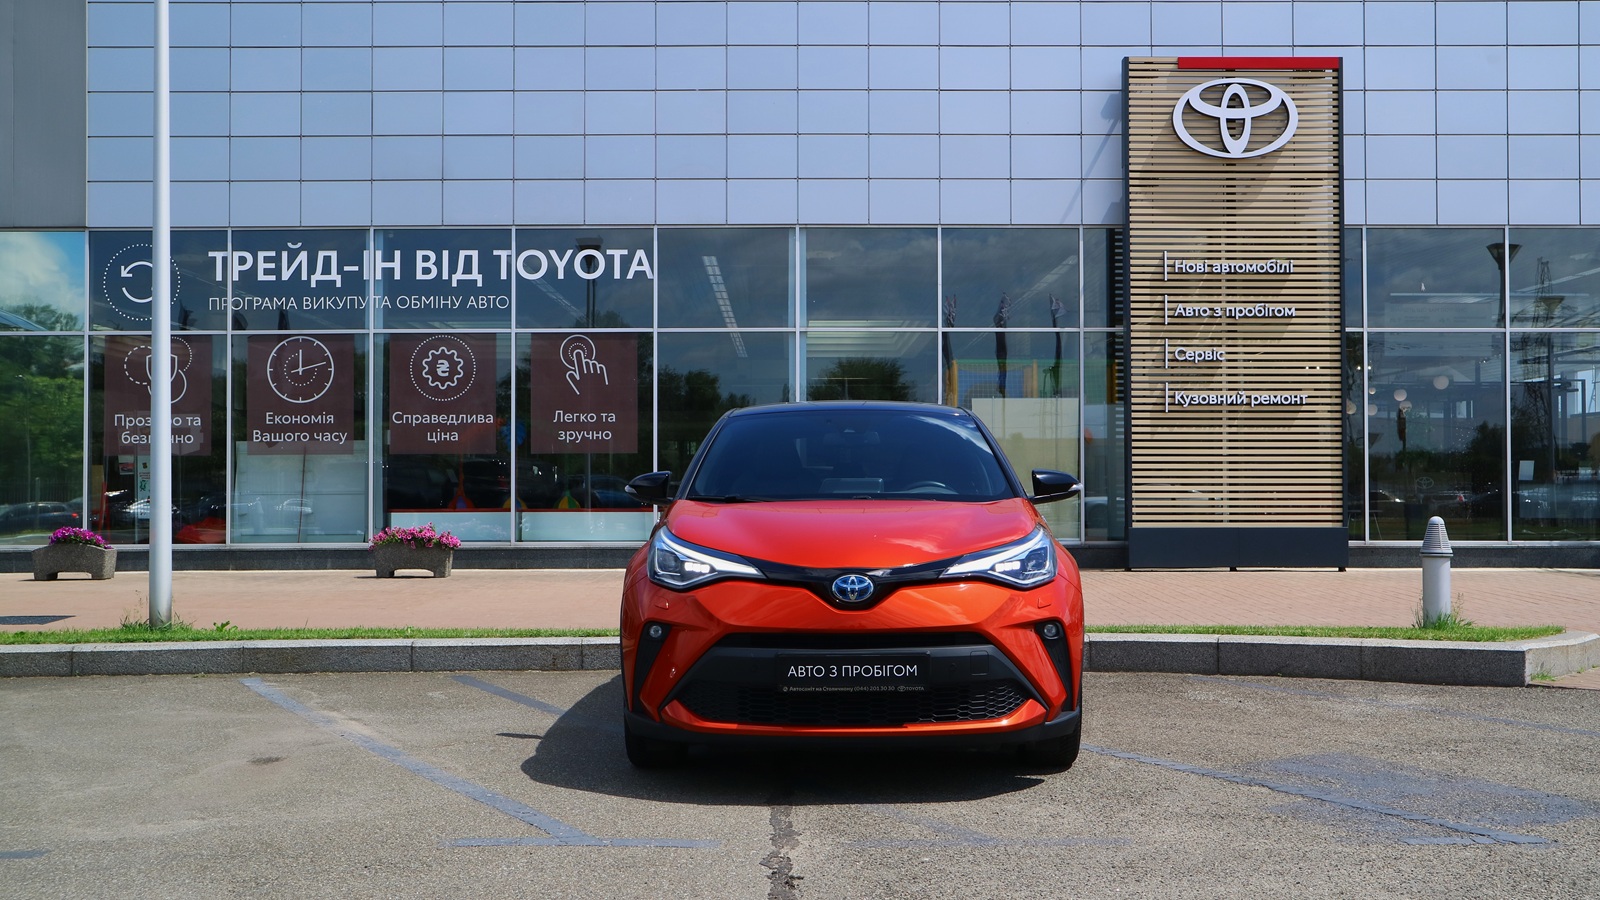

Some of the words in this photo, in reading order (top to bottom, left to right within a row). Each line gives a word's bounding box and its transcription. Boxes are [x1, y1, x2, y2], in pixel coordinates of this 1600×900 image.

[208, 242, 401, 288] ТРЕЙД-ІН
[416, 249, 483, 287] ВІД
[493, 249, 654, 280] TOYOTA
[1174, 260, 1209, 273] Нові
[1212, 260, 1295, 273] автомобілі
[209, 297, 298, 311] ПРОГРАМА
[302, 296, 369, 311] ВИКУПУ
[373, 296, 392, 310] ТА
[396, 295, 463, 310] ОБМІНУ
[466, 295, 510, 310] АВТО
[1174, 304, 1210, 317] Авто
[1213, 306, 1223, 317] з
[1225, 303, 1297, 320] пробігом
[1174, 347, 1226, 364] Сервіс
[1174, 391, 1247, 407] Кузовний
[1251, 393, 1309, 408] ремонт
[114, 413, 182, 429] Прозо
[186, 416, 202, 426] та
[265, 411, 335, 425] Економія
[392, 411, 494, 427] Справедлива
[553, 410, 597, 423] Легко
[600, 412, 616, 423] та
[121, 431, 194, 444] безно
[252, 429, 309, 443] Вашого
[313, 431, 348, 445] часу
[427, 429, 459, 443] ціна
[557, 430, 612, 443] зручно
[787, 665, 826, 677] АВТО
[829, 665, 838, 677] З
[841, 664, 918, 677] ПРОБІГОМ
